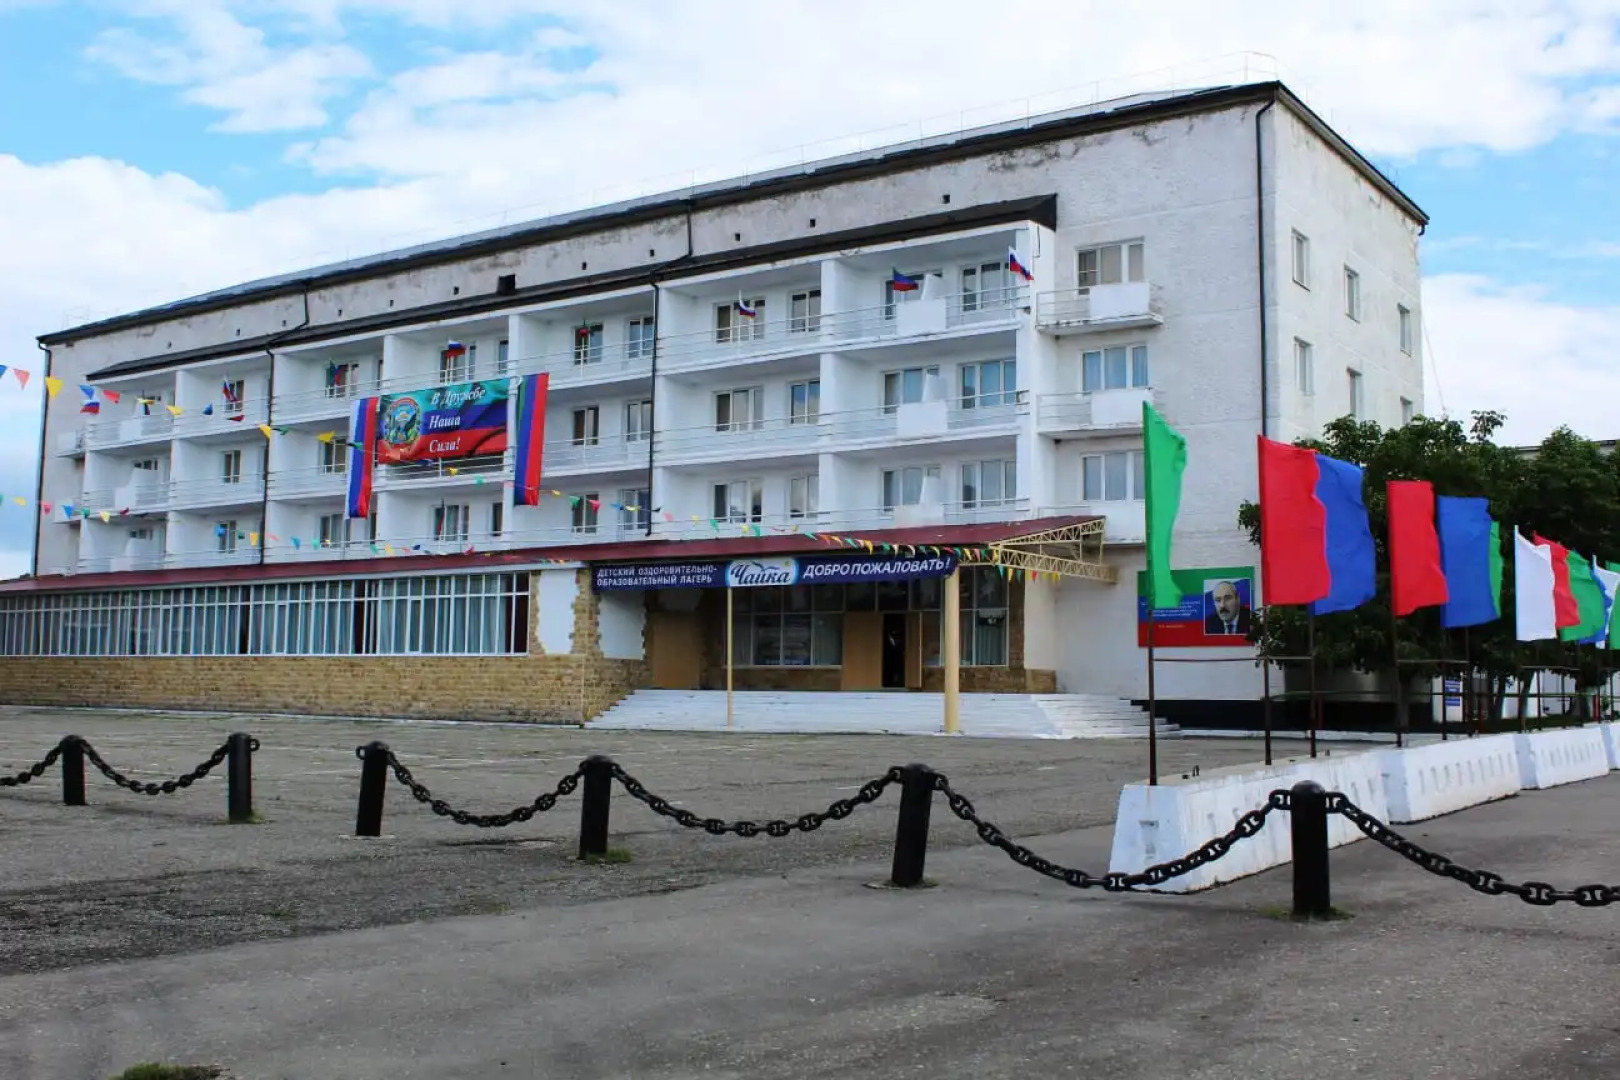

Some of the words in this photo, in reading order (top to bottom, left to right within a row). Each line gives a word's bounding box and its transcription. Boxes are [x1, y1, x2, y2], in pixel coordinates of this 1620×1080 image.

[431, 391, 441, 405] В
[442, 386, 485, 406] Дружбе
[429, 415, 460, 429] Наша
[429, 437, 460, 453] Сила!
[597, 568, 635, 578] ДЕТСКИЙ
[638, 565, 718, 576] ОЗДОРОВИТЕЛЬНО-
[730, 563, 791, 584] Чайка
[803, 564, 850, 579] ДОБРО
[851, 558, 950, 575] ПОЖАЛОВАТЬ!
[597, 575, 677, 586] ОБРАЗОВАТЕЛЬНЫЙ
[680, 574, 712, 584] ЛАГЕРЬ
